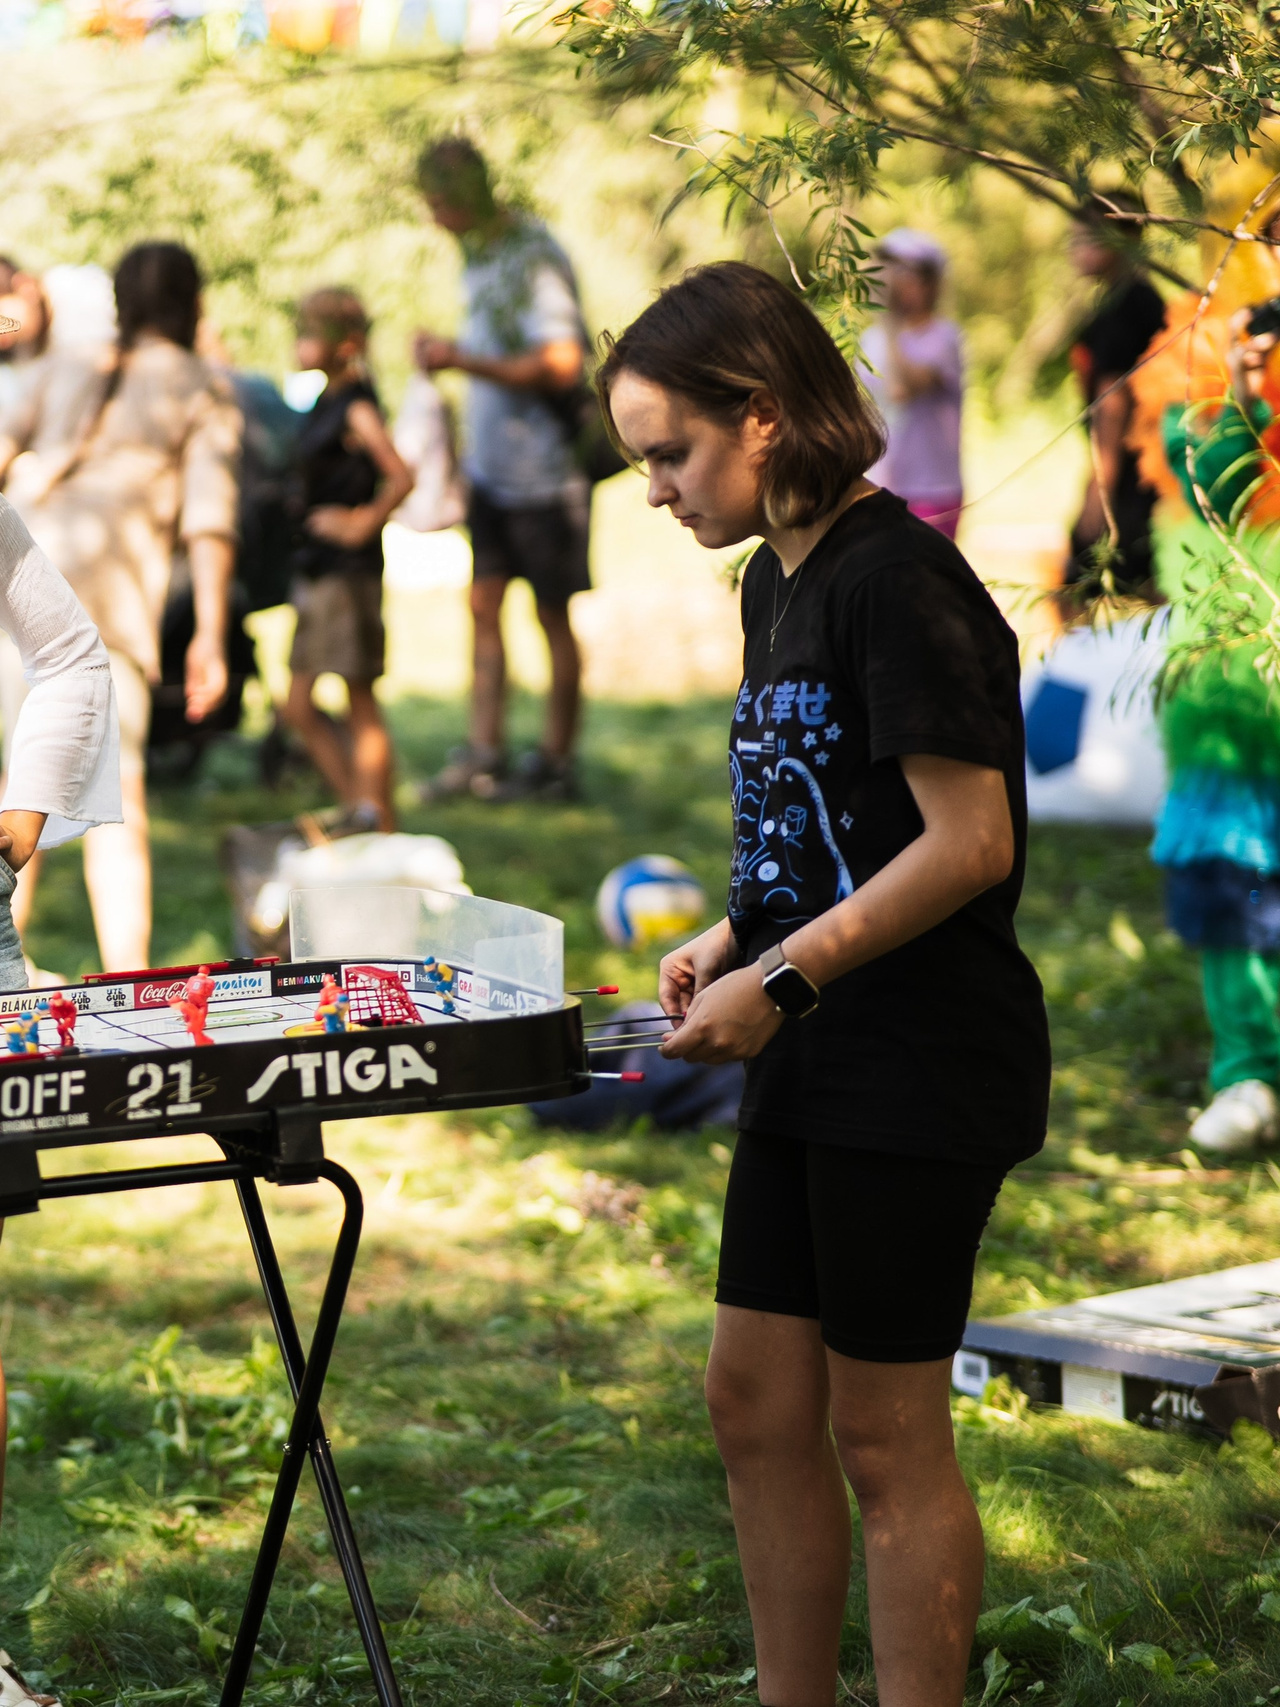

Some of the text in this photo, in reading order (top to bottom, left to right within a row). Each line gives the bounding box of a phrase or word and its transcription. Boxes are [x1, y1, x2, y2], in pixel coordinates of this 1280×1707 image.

[1, 1069, 87, 1118] OFF
[127, 1058, 202, 1121] 21
[246, 1044, 438, 1104] STIGA
